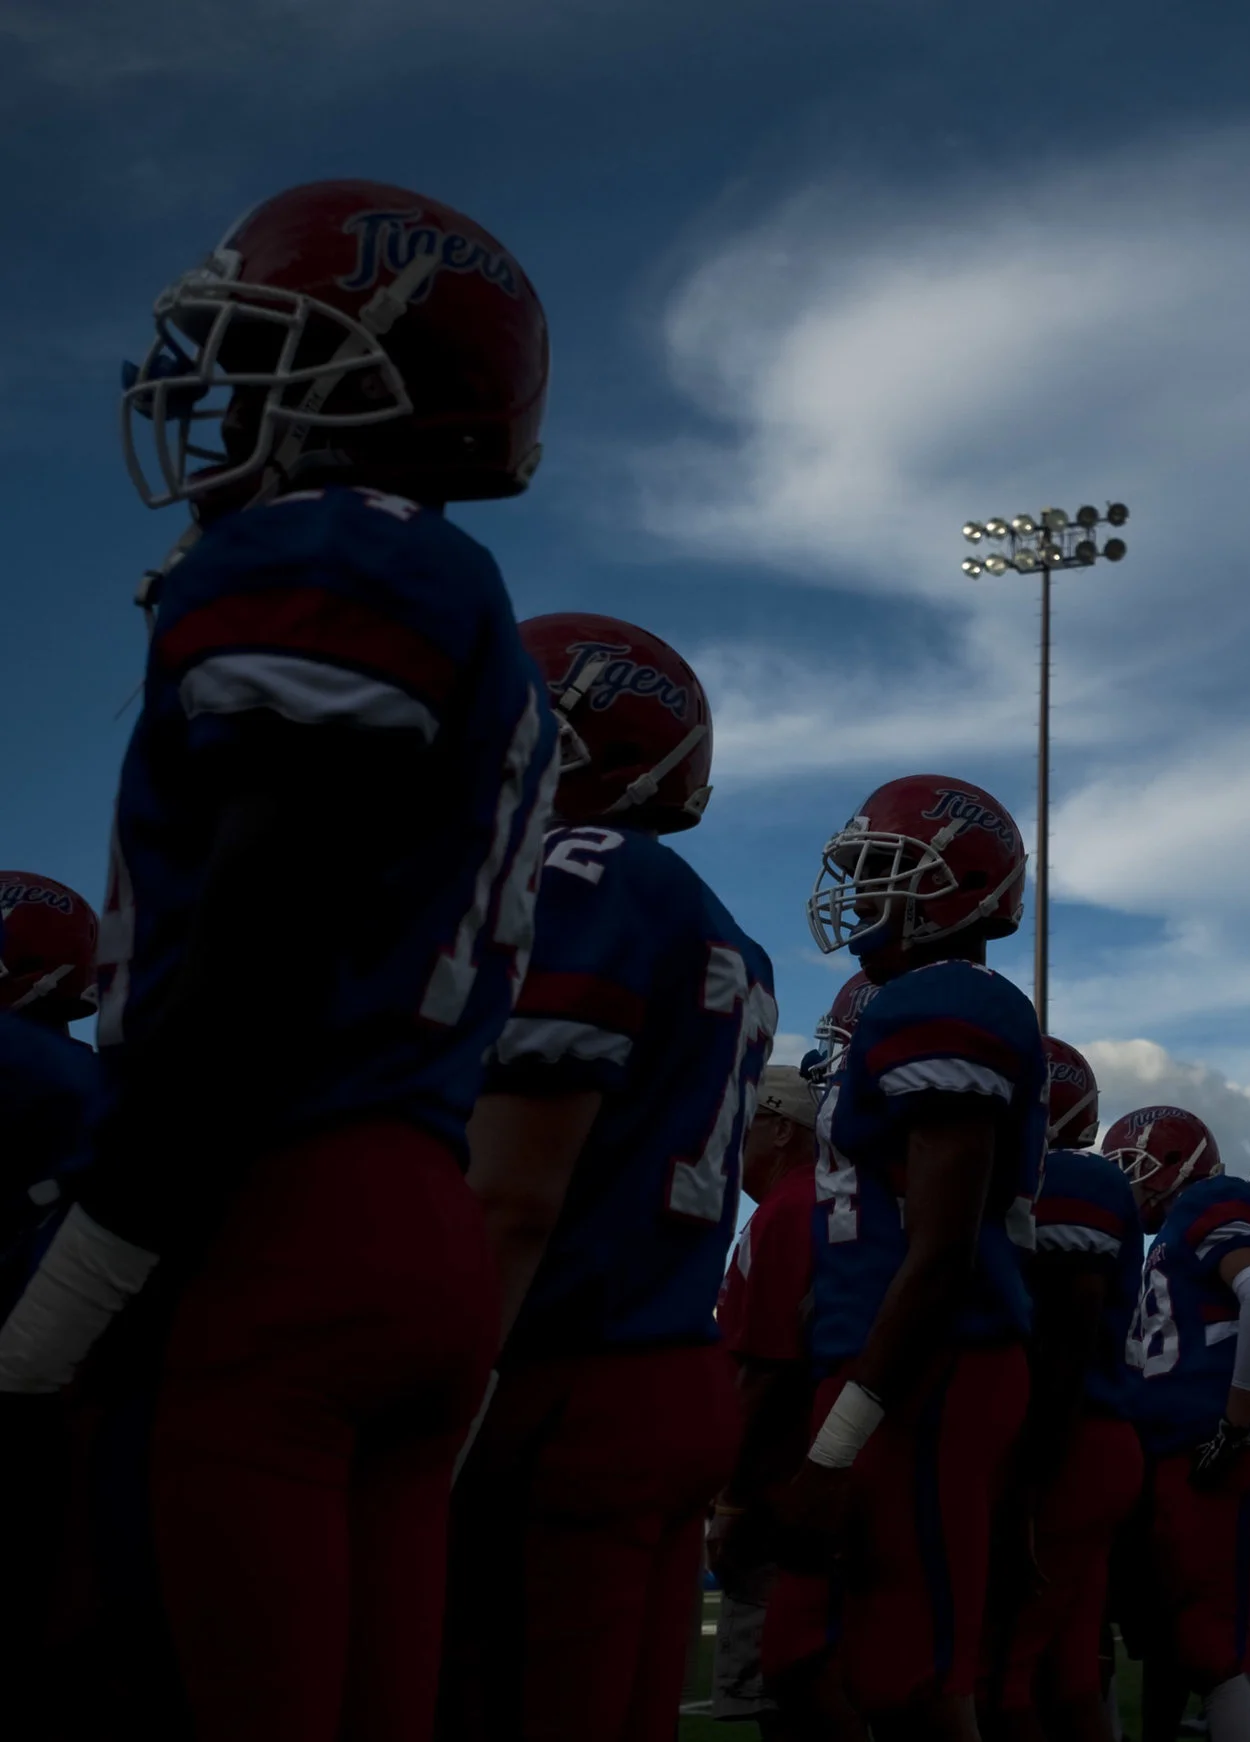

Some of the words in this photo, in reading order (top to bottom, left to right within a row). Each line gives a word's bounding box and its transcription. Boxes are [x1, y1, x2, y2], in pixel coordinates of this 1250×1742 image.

[332, 207, 520, 305] Tigers
[547, 641, 688, 720] Tgers
[921, 788, 1016, 853] Tigers
[0, 876, 74, 916] gers
